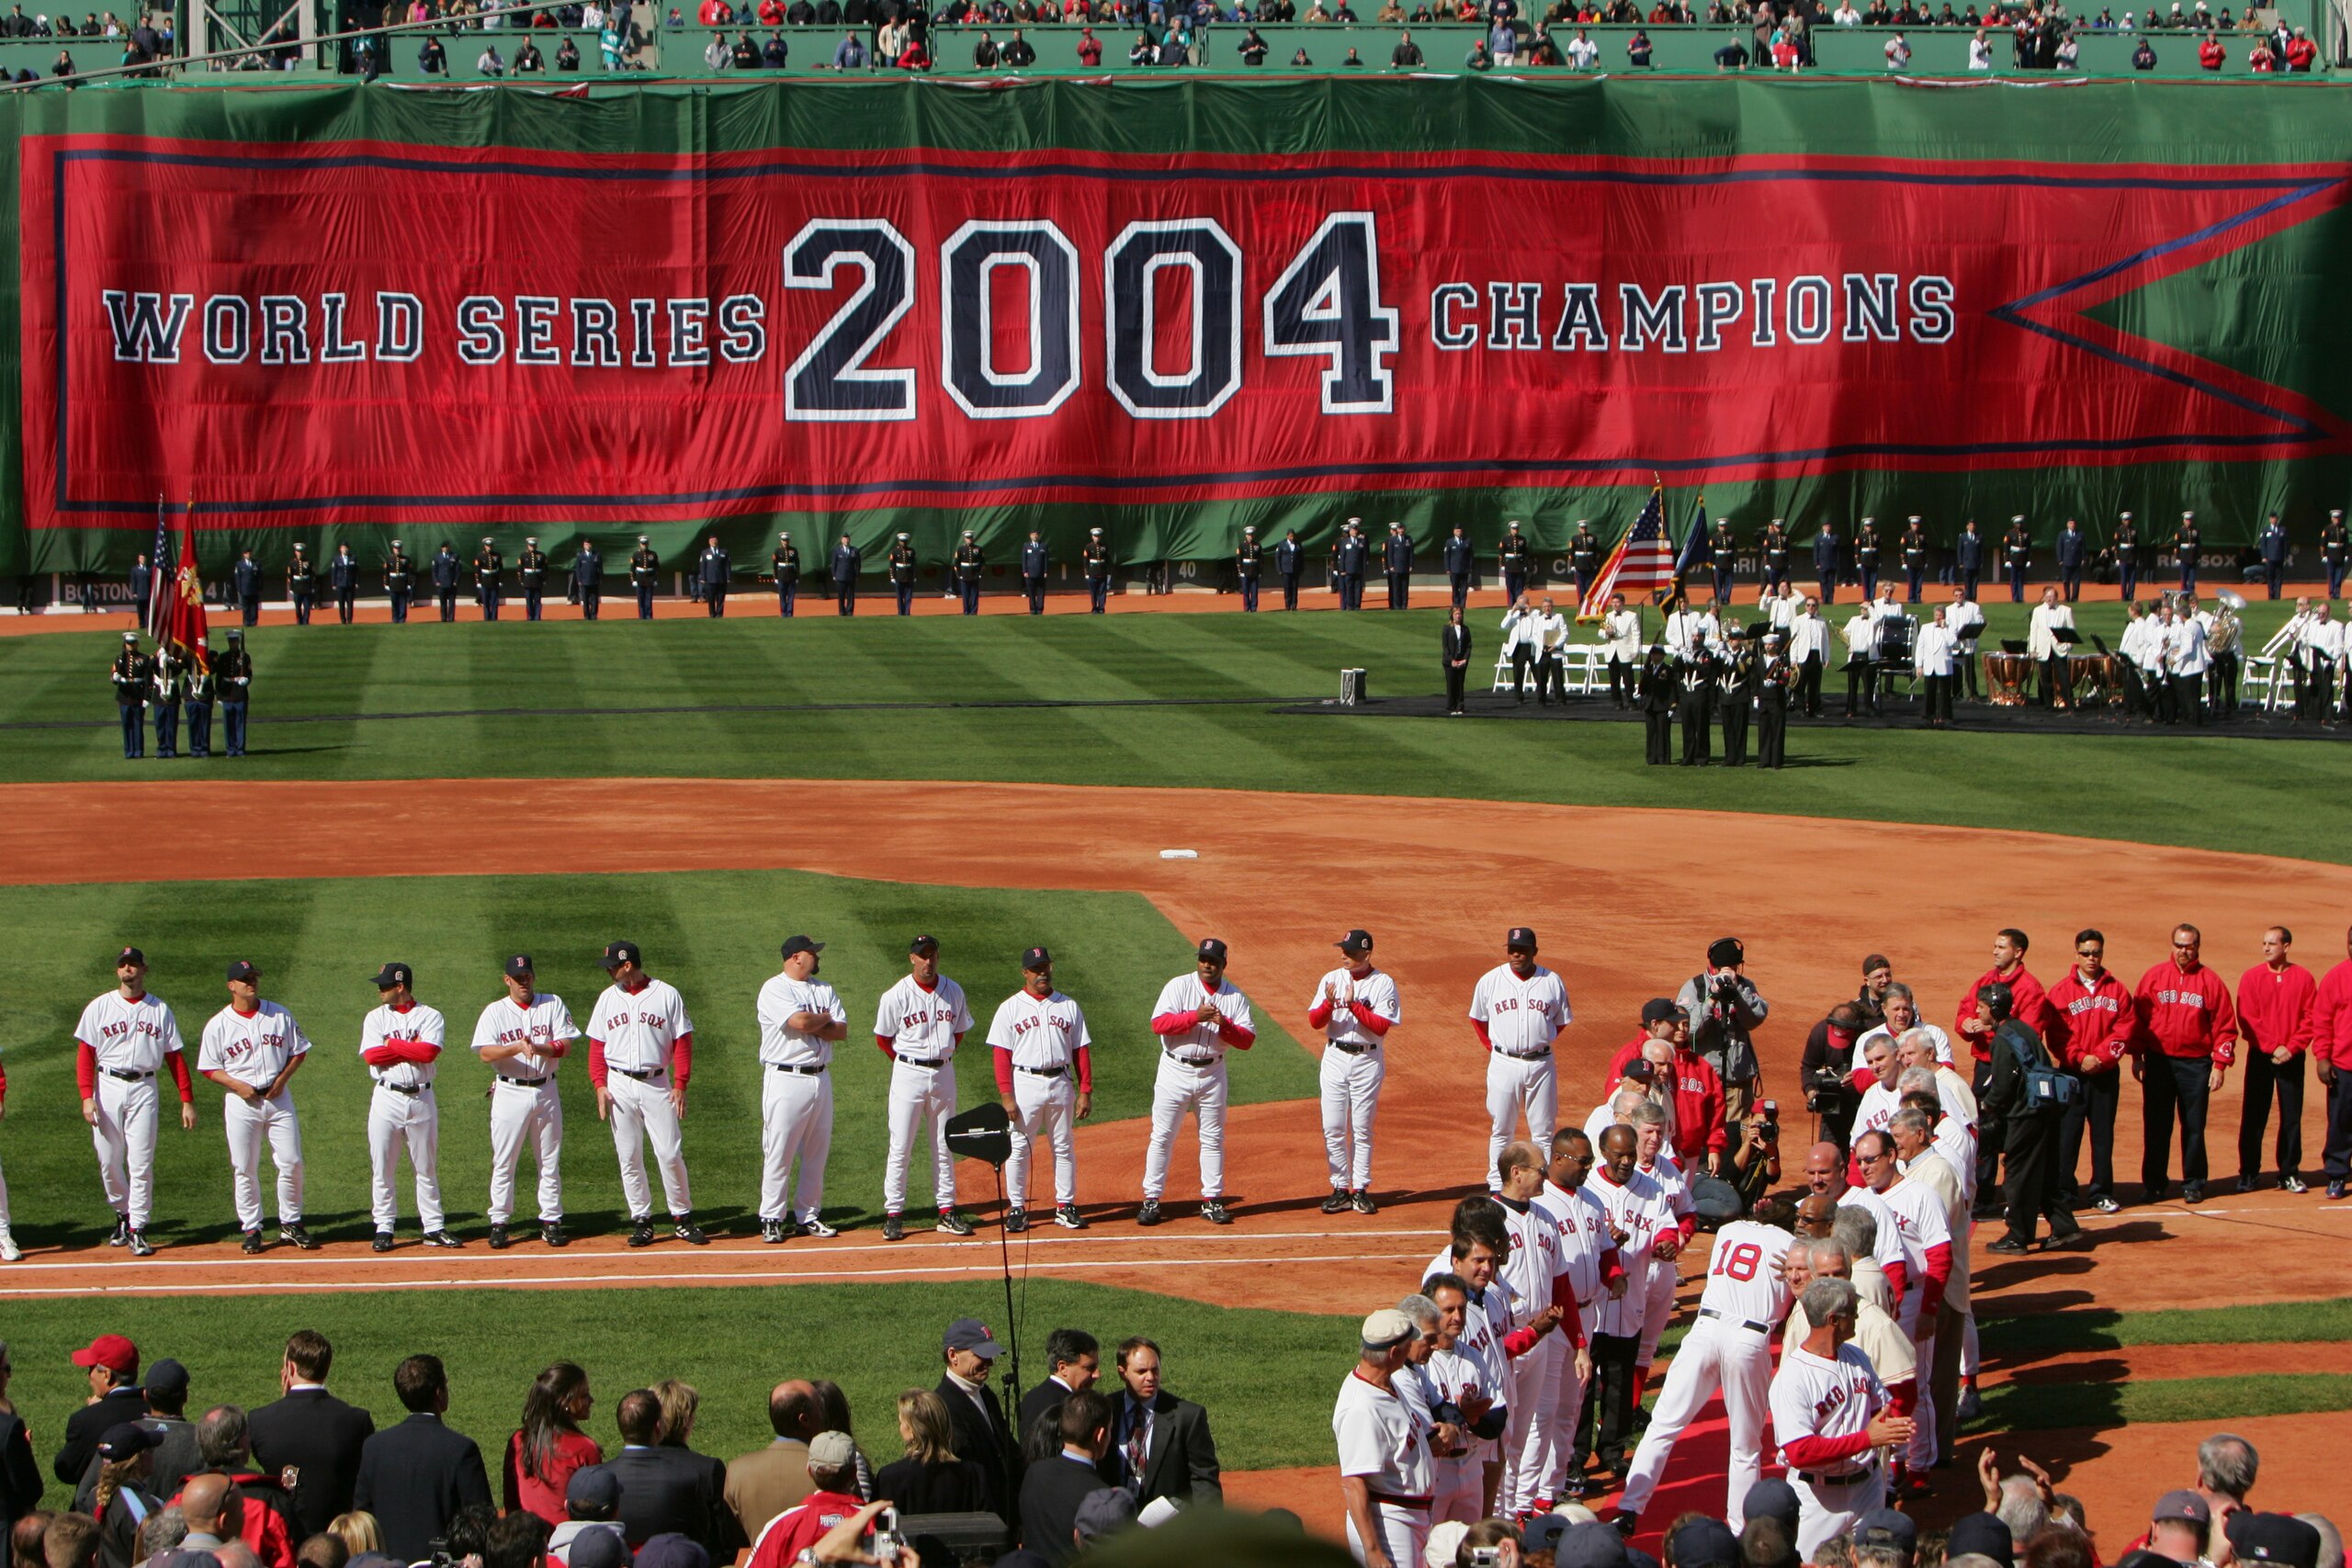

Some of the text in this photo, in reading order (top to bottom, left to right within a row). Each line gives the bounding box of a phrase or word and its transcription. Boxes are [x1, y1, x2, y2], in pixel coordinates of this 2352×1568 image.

[101, 289, 424, 365] WORLD
[458, 293, 765, 367] SERIES
[783, 210, 1399, 422] 2004
[1430, 273, 1956, 353] CHAMPIONS
[1178, 560, 1197, 579] 40
[1494, 998, 1551, 1017] RED SOX
[2068, 995, 2119, 1016] RED SOX
[2156, 989, 2203, 1009] RED SOX
[607, 1011, 666, 1031] RED SOX
[903, 1010, 928, 1029] RED
[1014, 1015, 1072, 1036] RED SOX
[102, 1021, 162, 1040] RED SOX
[500, 1030, 524, 1044] RED
[226, 1033, 285, 1058] RED SOX
[1557, 1218, 1577, 1236] ED
[1624, 1209, 1655, 1233] SOX
[1712, 1239, 1763, 1282] 18
[1814, 1384, 1846, 1419] RED
